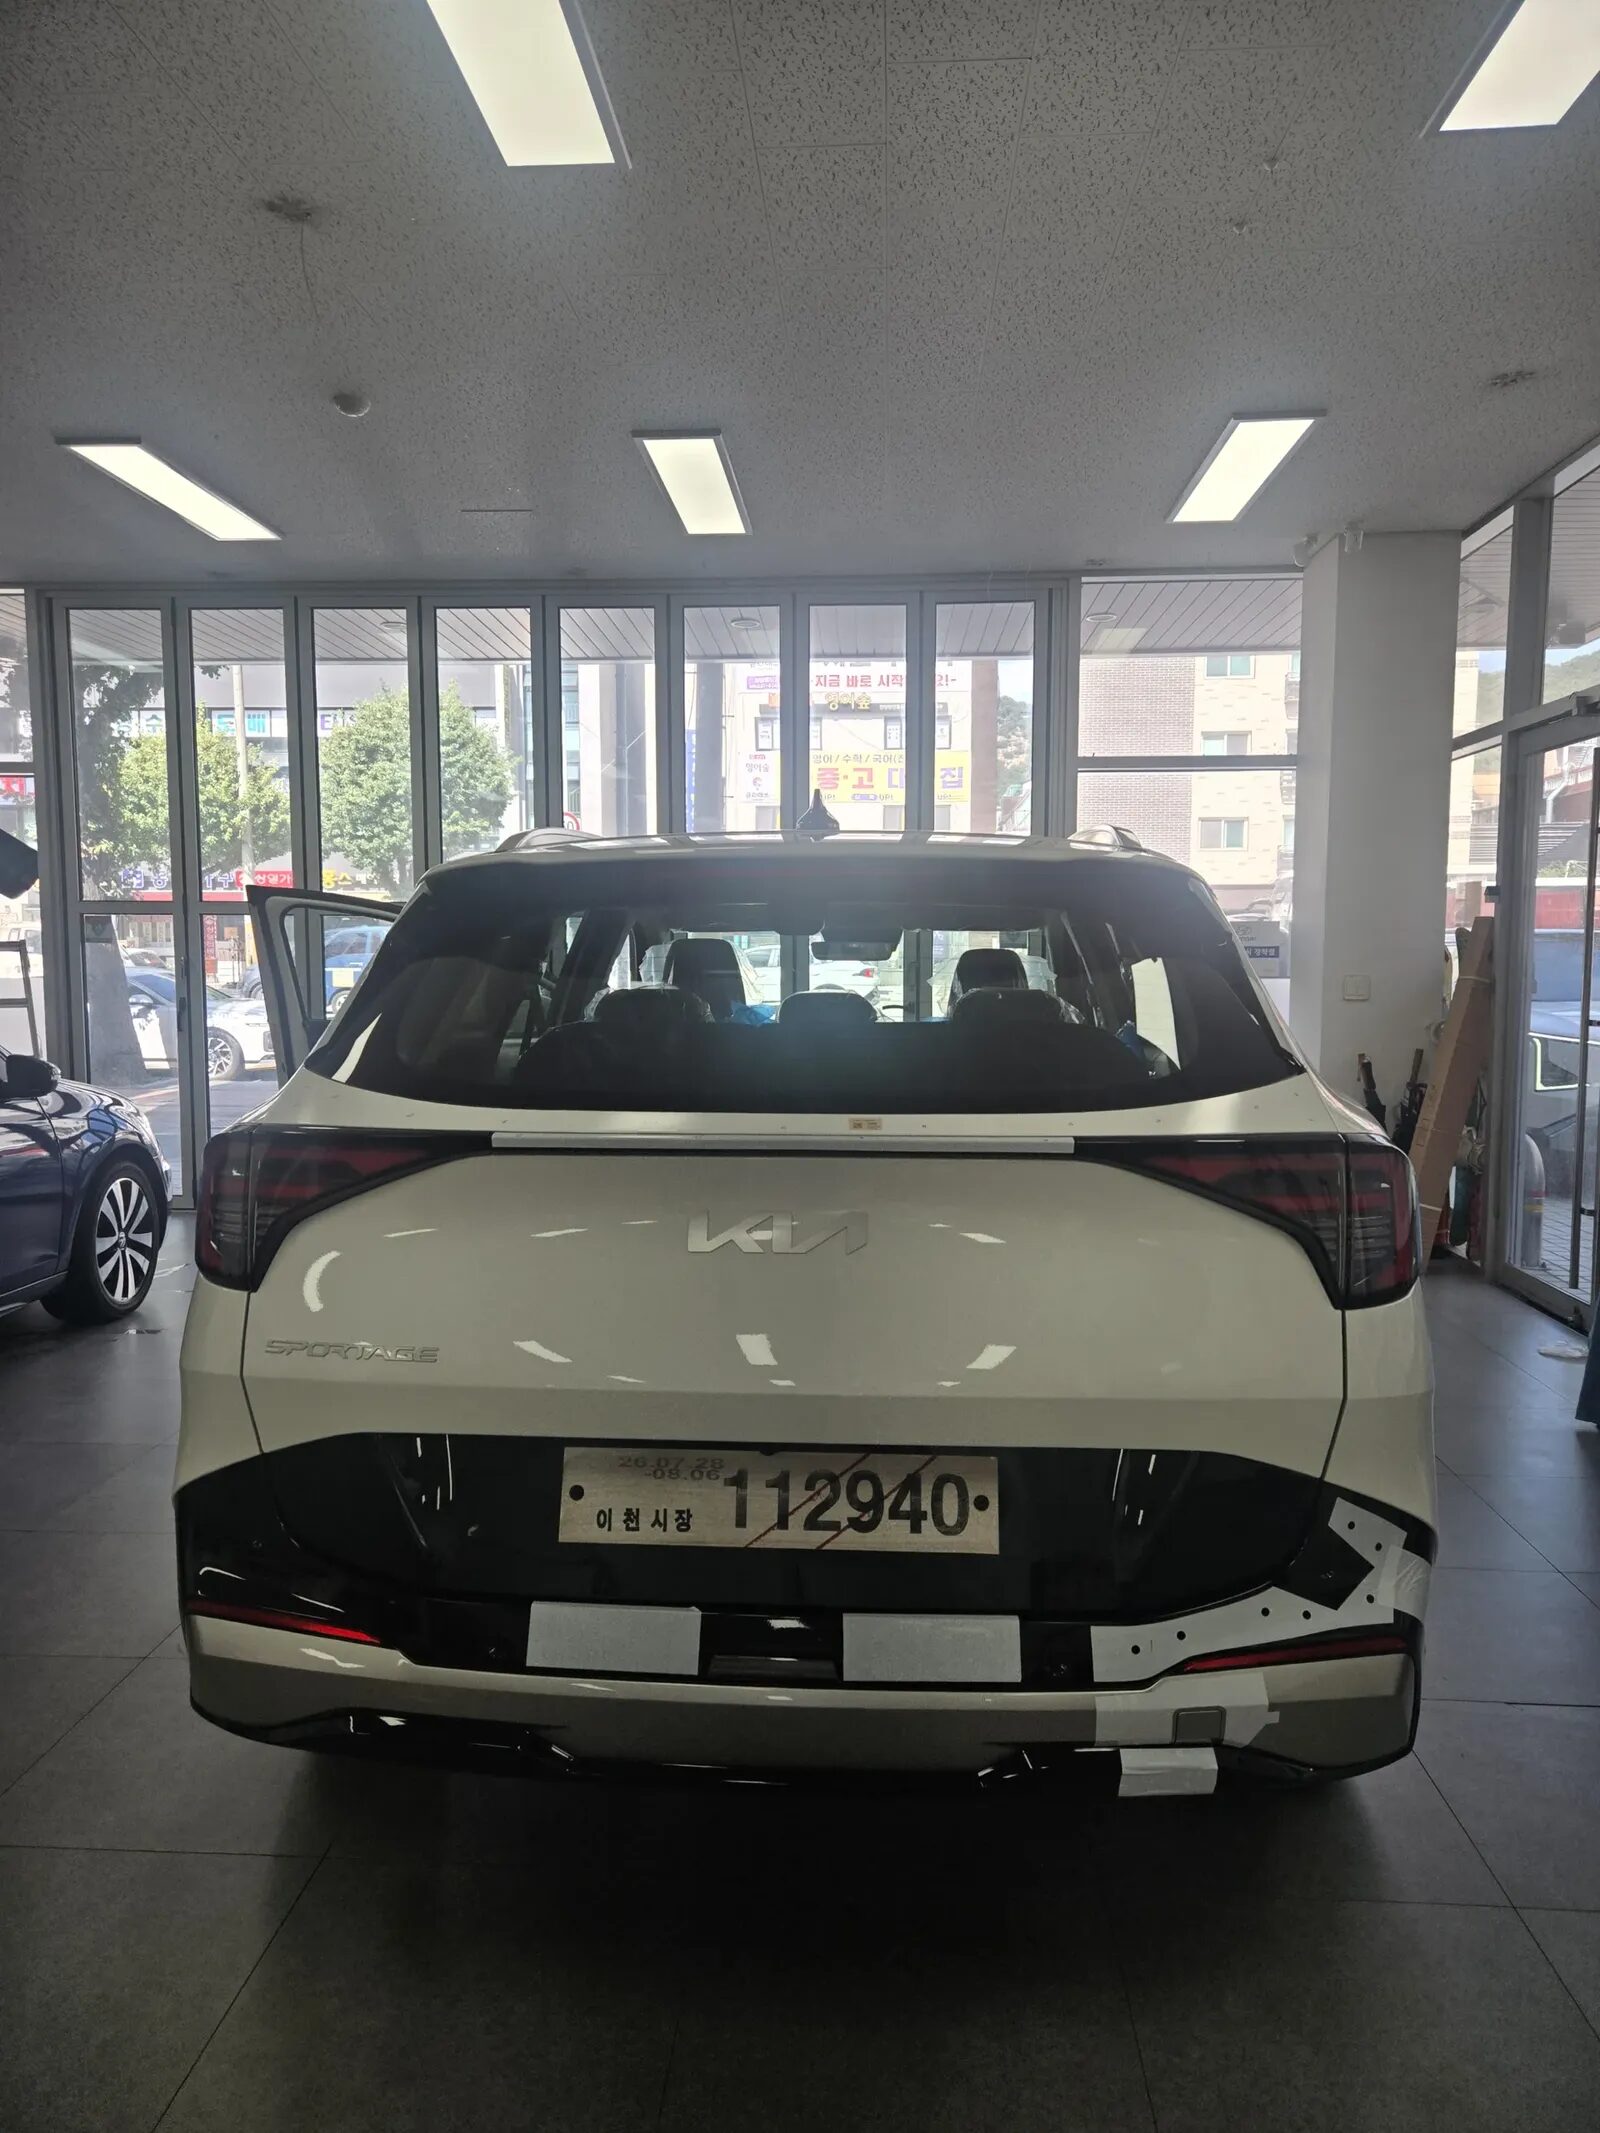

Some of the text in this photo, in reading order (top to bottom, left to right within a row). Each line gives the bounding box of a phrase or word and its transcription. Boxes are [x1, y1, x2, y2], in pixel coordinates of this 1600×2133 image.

[815, 674, 841, 688] 지금
[846, 674, 872, 688] 바로
[825, 691, 872, 711] 영어숲
[687, 1209, 869, 1256] KIA
[264, 1339, 440, 1364] SPORTAGE
[723, 1467, 970, 1537] 112940
